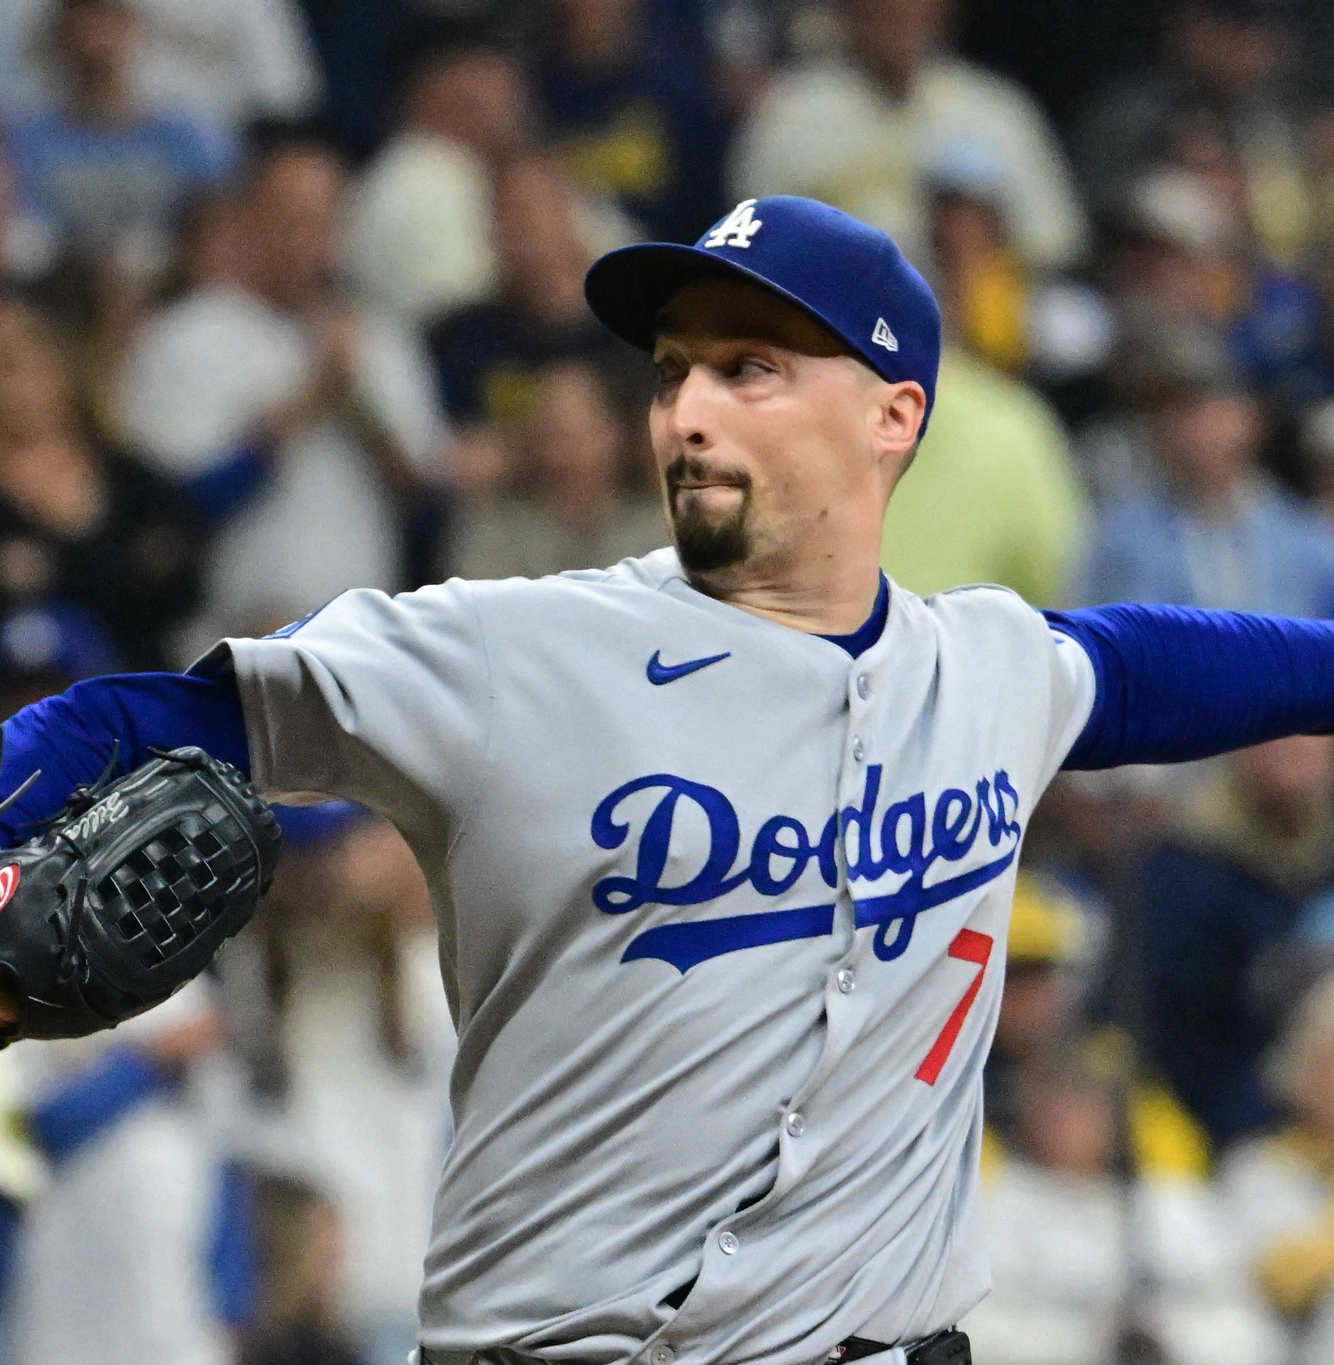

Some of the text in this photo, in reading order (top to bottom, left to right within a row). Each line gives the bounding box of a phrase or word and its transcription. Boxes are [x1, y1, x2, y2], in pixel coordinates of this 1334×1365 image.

[704, 198, 763, 249] LA
[591, 764, 1021, 962] Dodgers
[914, 928, 994, 1087] 7
